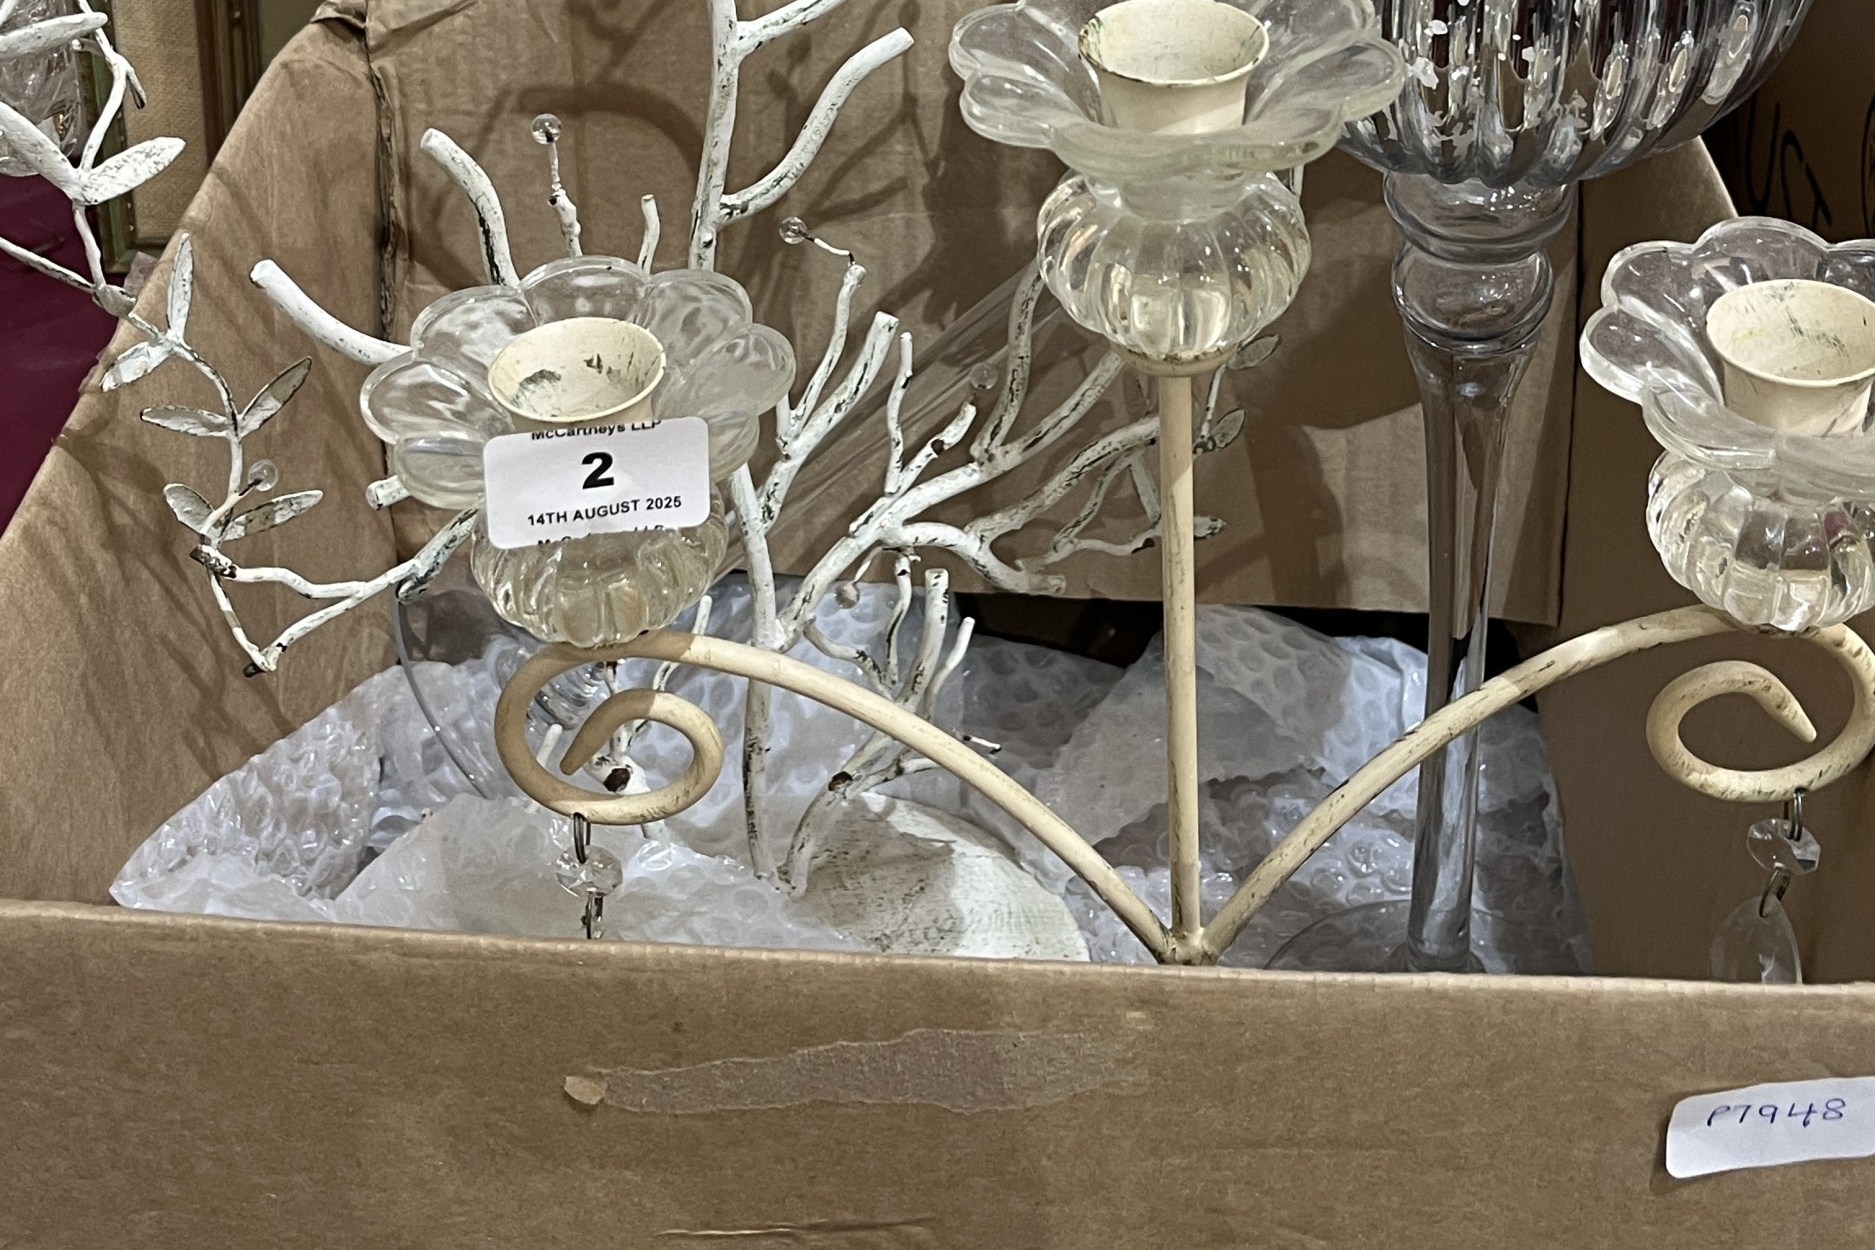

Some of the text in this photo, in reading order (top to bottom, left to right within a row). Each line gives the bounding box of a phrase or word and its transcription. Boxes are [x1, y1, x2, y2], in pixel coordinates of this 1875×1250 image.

[581, 451, 615, 490] 2
[527, 495, 682, 526] 14TH AUGUST 2025
[1706, 1097, 1846, 1128] P7948
